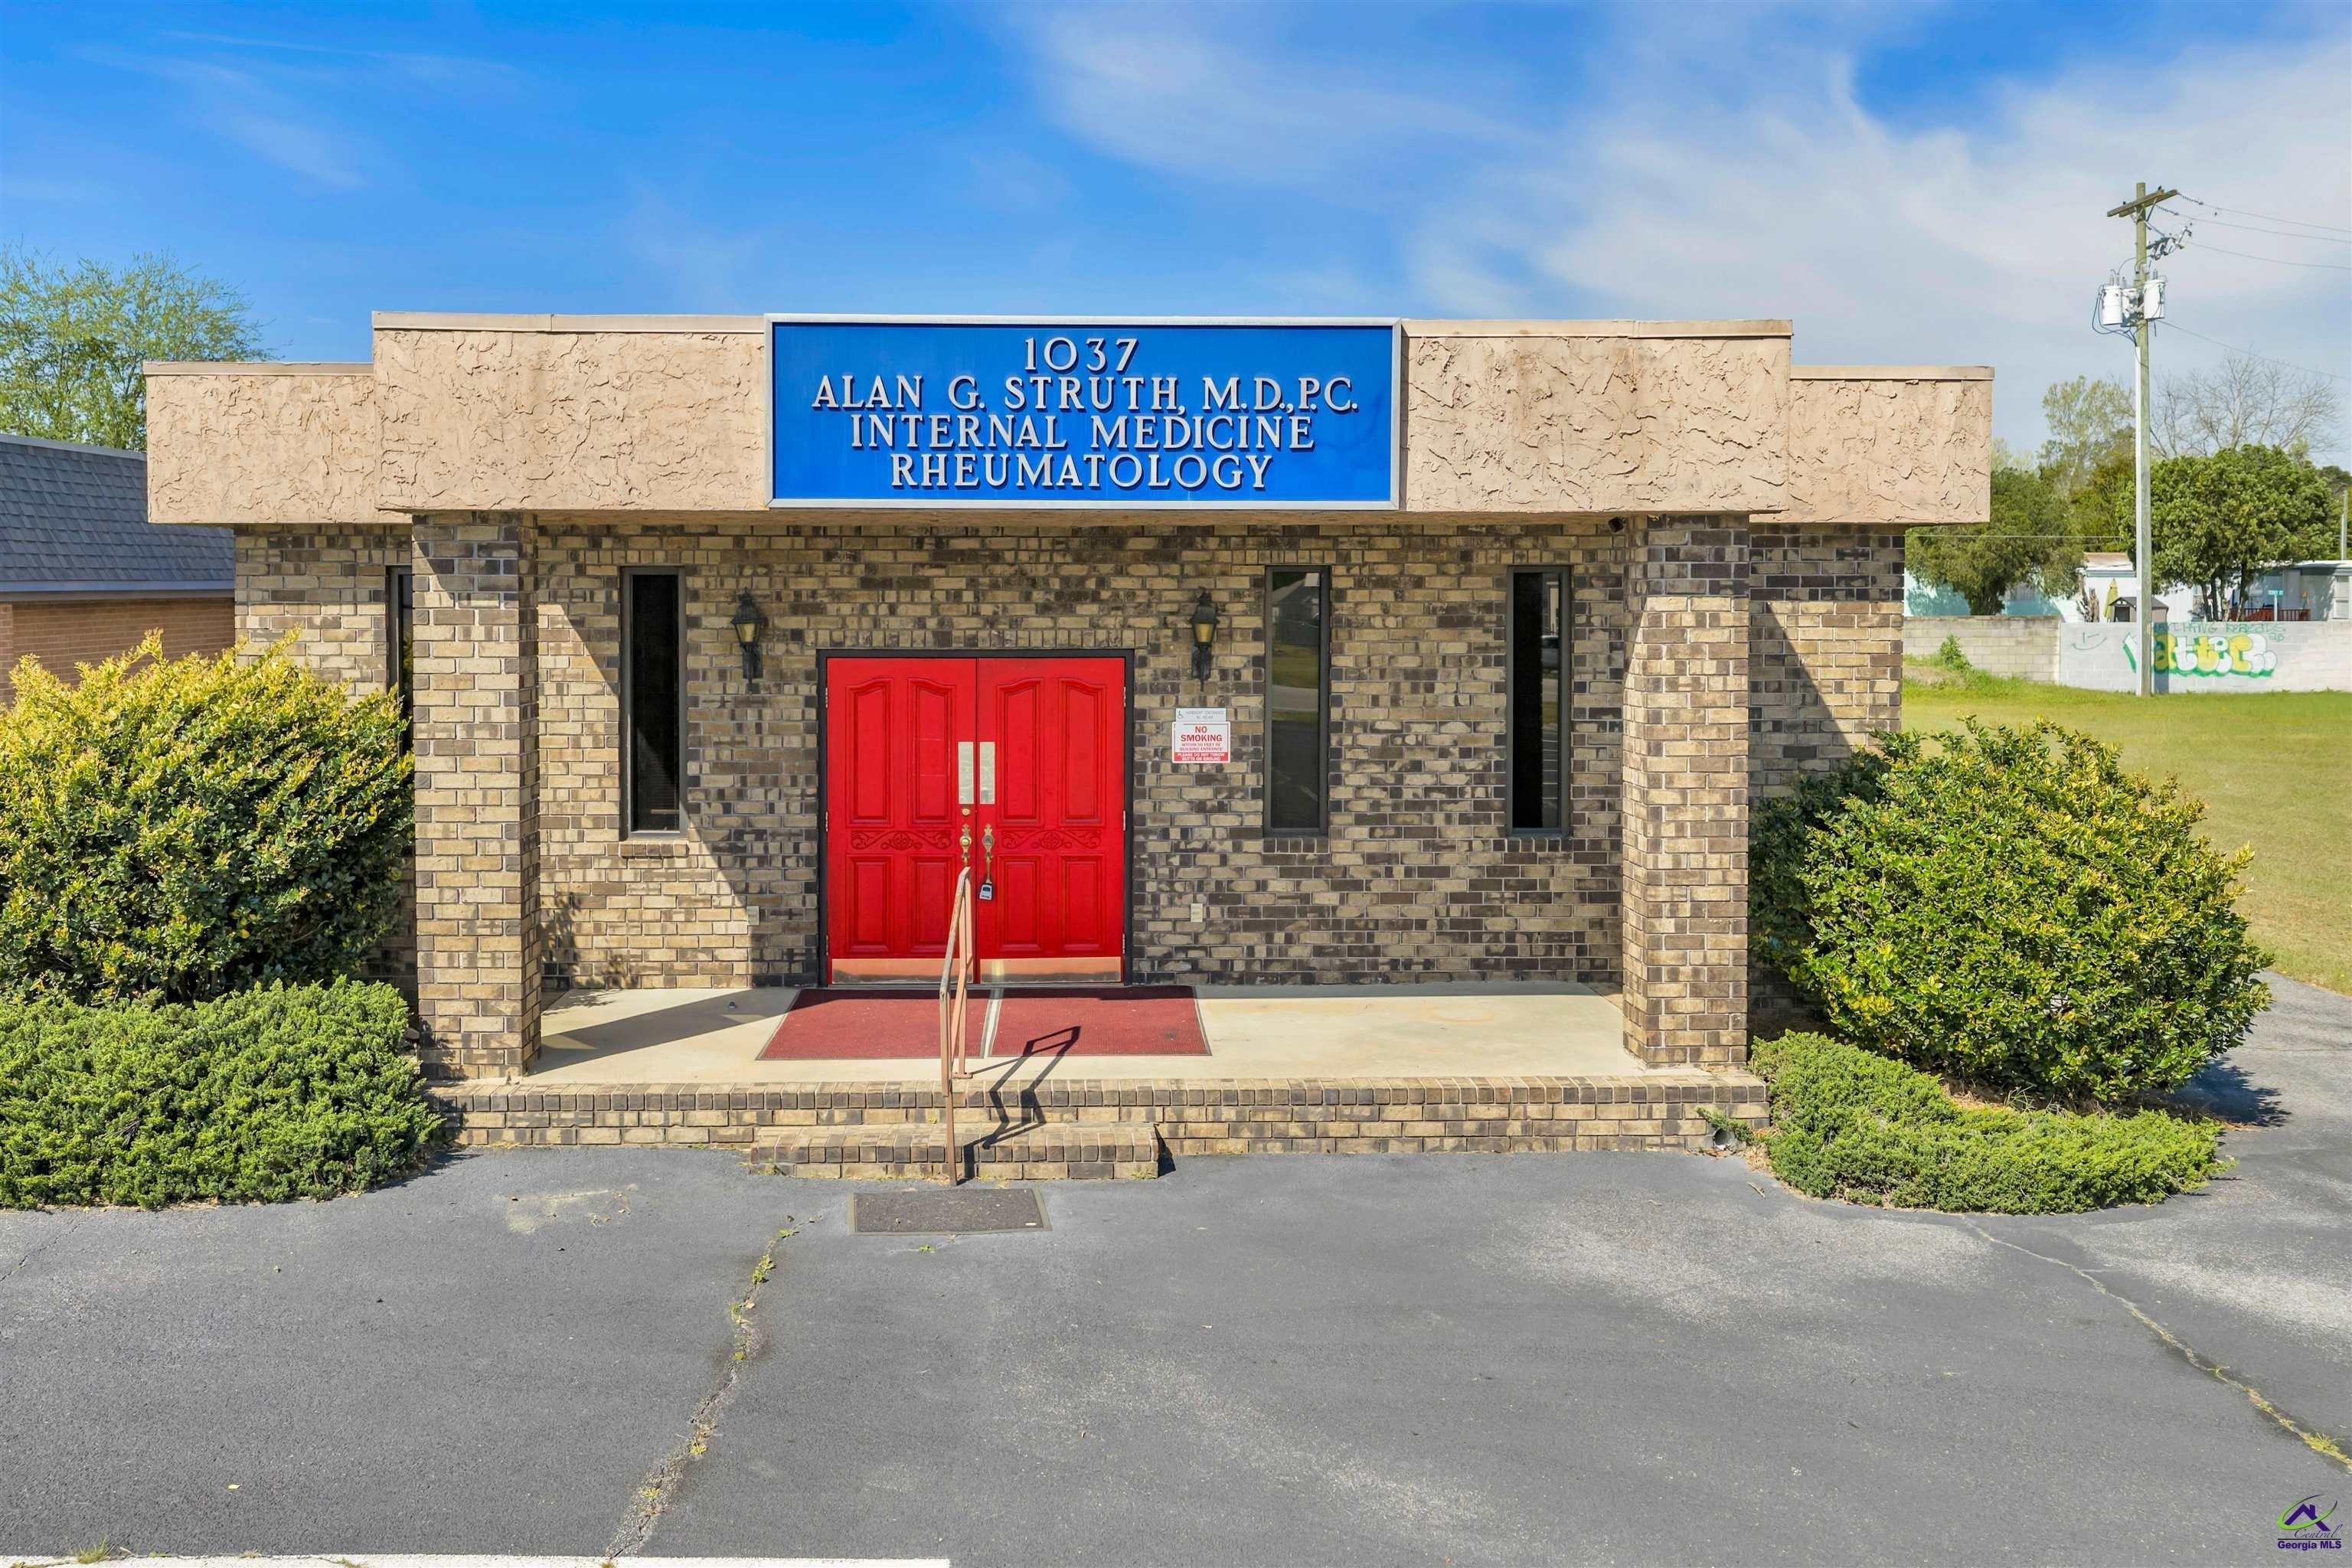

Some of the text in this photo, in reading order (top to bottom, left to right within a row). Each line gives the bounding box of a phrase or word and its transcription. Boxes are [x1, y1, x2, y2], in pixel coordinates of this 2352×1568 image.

[1024, 337, 1138, 372] 1037
[812, 375, 923, 409] ALAN
[948, 375, 986, 410] G.
[1004, 376, 1186, 415] STRUTH,
[851, 414, 1315, 449] INTERNAL MEDICINE
[890, 453, 1272, 488] RHEUMATOLOGY
